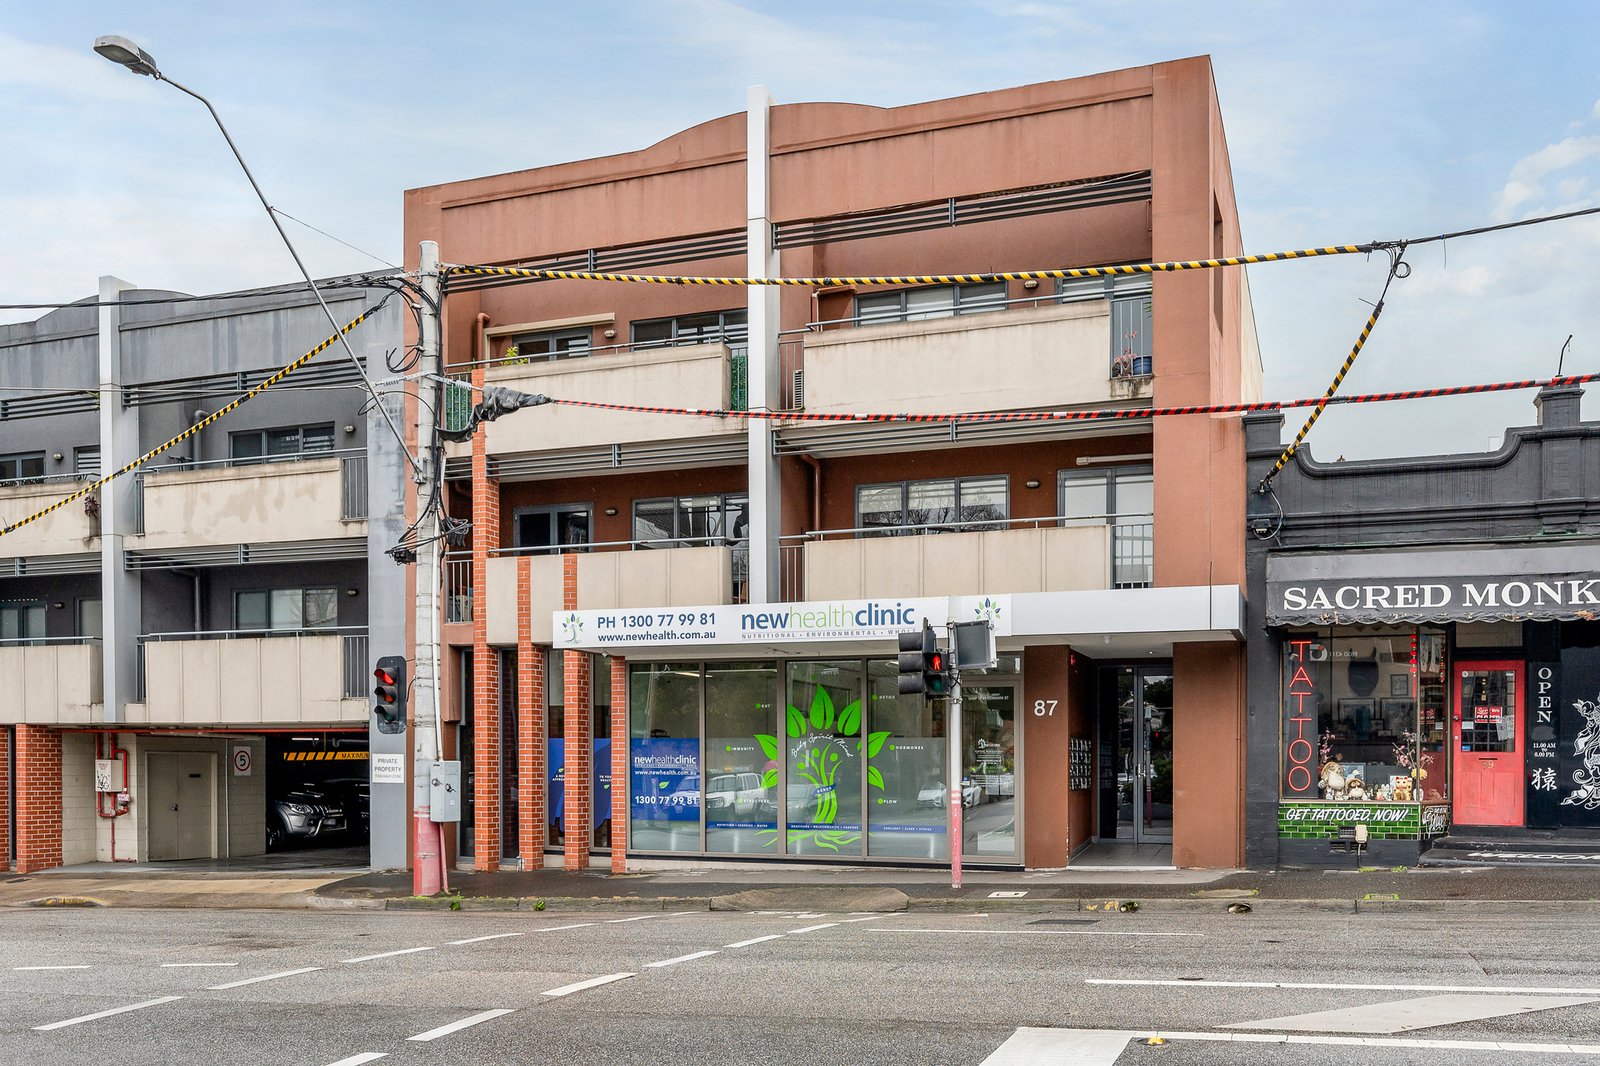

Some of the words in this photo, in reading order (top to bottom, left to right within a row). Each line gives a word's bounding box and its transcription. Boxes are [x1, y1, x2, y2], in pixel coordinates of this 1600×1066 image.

[1283, 584, 1452, 611] SACRED
[1462, 578, 1600, 607] MONK
[597, 616, 616, 628] PH
[621, 614, 653, 628] 1300
[658, 614, 674, 626] 77
[678, 612, 696, 626] 99
[700, 612, 716, 625] 81
[742, 602, 915, 630] newhealthclinic
[598, 630, 716, 642] www.newhealth.com.au
[806, 630, 876, 638] ENVIRONMENTAL
[1536, 667, 1552, 723] OPEN
[1034, 700, 1058, 716] 87
[1288, 640, 1313, 792] TATTOO
[240, 754, 246, 766] 5
[634, 754, 697, 764] newhealthclinic
[1531, 767, 1558, 792] 猿
[634, 796, 656, 804] 1300
[658, 796, 670, 804] 77
[672, 796, 686, 806] 99
[687, 796, 697, 805] 81
[1286, 808, 1310, 821] GET
[1310, 808, 1370, 822] TATTOOED,
[1373, 808, 1409, 822] NOW!
